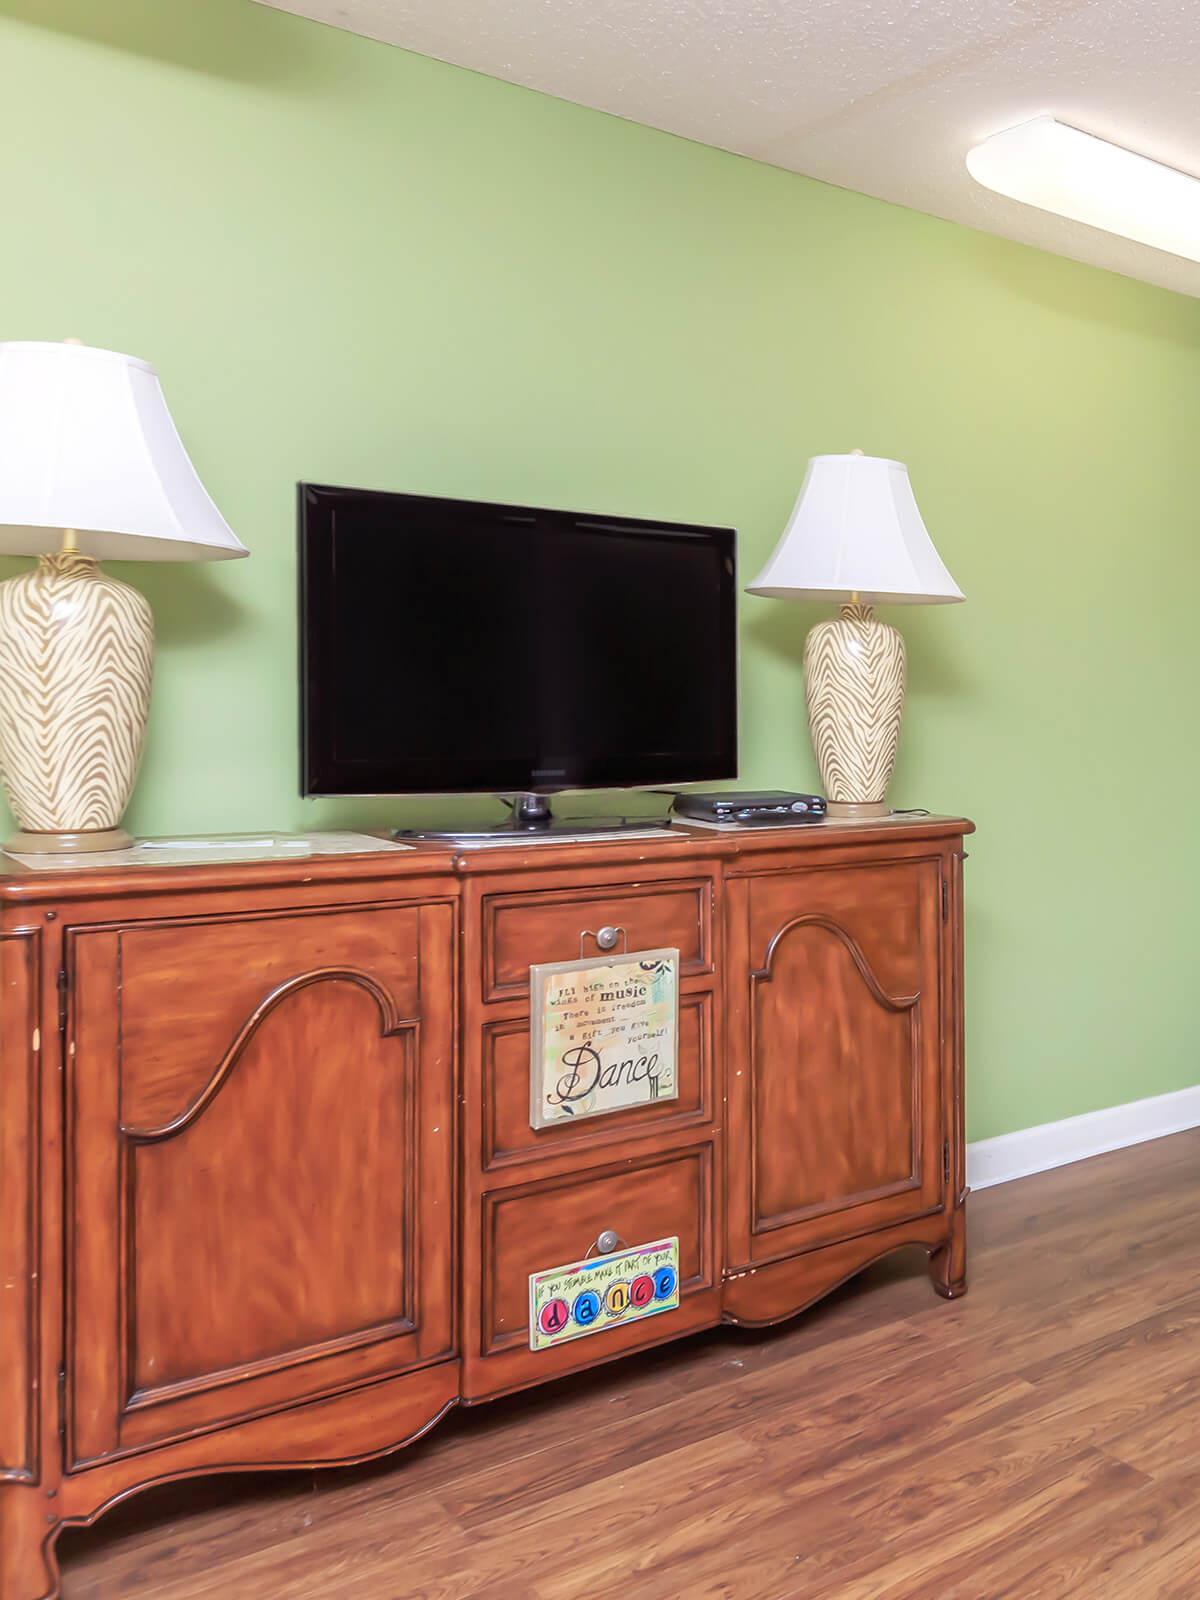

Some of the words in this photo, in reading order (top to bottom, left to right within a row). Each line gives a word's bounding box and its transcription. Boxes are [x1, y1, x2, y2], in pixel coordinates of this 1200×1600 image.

[584, 982, 605, 993] high
[624, 978, 639, 986] the
[585, 994, 595, 1002] of
[599, 986, 647, 1002] music
[563, 1010, 589, 1020] There
[597, 1006, 606, 1014] is
[555, 1024, 565, 1032] in
[582, 1029, 602, 1040] gift
[610, 1025, 626, 1034] you
[631, 1020, 649, 1030] give
[547, 1040, 661, 1105] Dance
[538, 1284, 545, 1297] IF
[549, 1282, 561, 1297] YOU
[564, 1274, 593, 1291] STUMBLE
[594, 1267, 613, 1281] MAKE
[615, 1262, 624, 1275] IT
[624, 1255, 642, 1273] PART
[642, 1254, 652, 1265] OF
[654, 1250, 673, 1266] YOUR
[547, 1274, 671, 1328] dance
